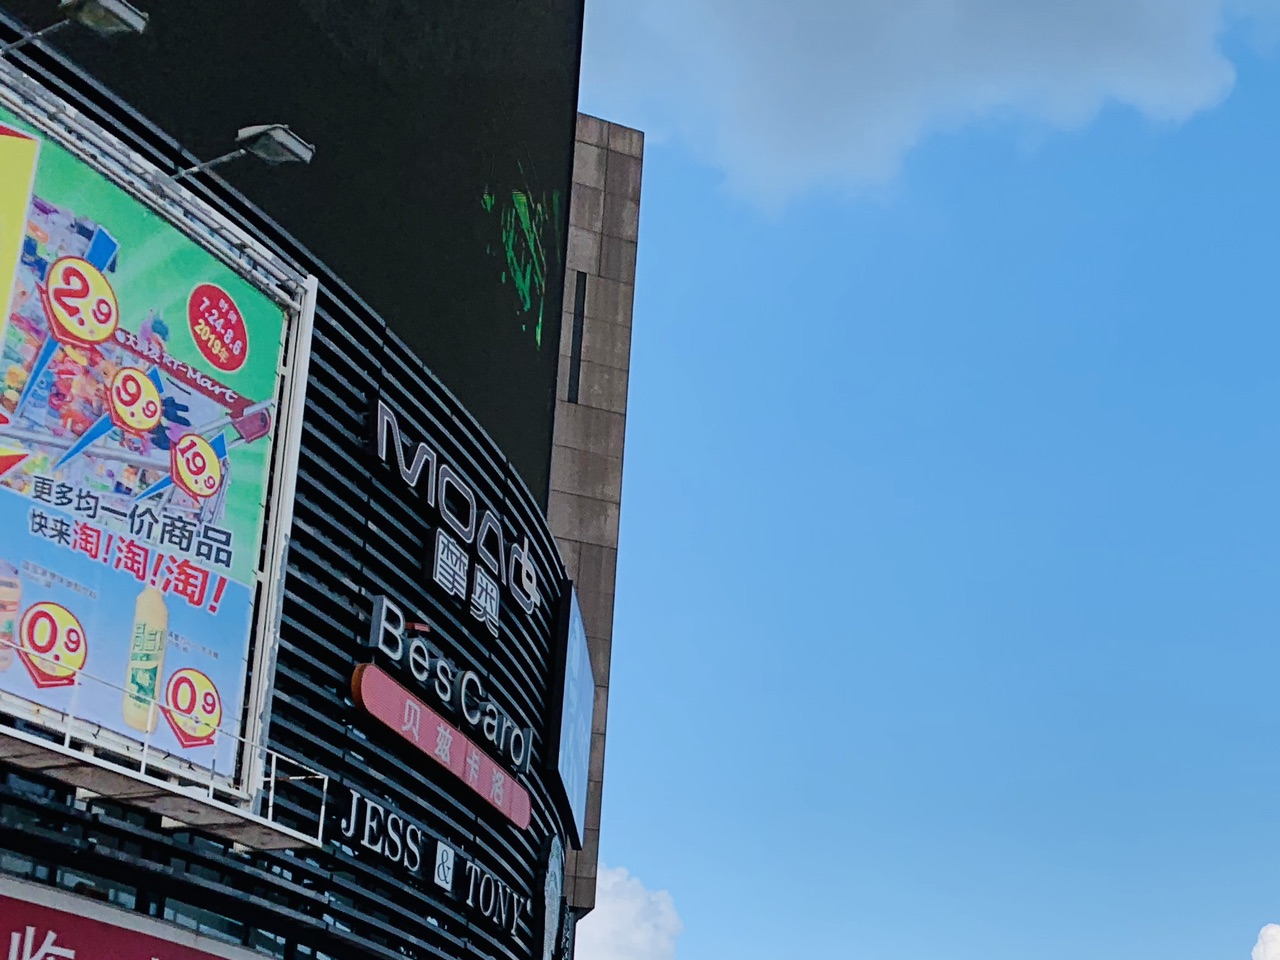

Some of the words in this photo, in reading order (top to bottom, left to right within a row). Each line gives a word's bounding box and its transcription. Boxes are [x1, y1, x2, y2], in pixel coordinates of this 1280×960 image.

[54, 266, 112, 327] 2.9
[193, 318, 229, 363] 2019年
[115, 375, 158, 418] 9.9
[176, 438, 217, 490] 19.9
[32, 474, 234, 569] 更多均一价商品
[27, 609, 81, 663] 0.9
[340, 788, 424, 873] JESS
[434, 843, 455, 888] &
